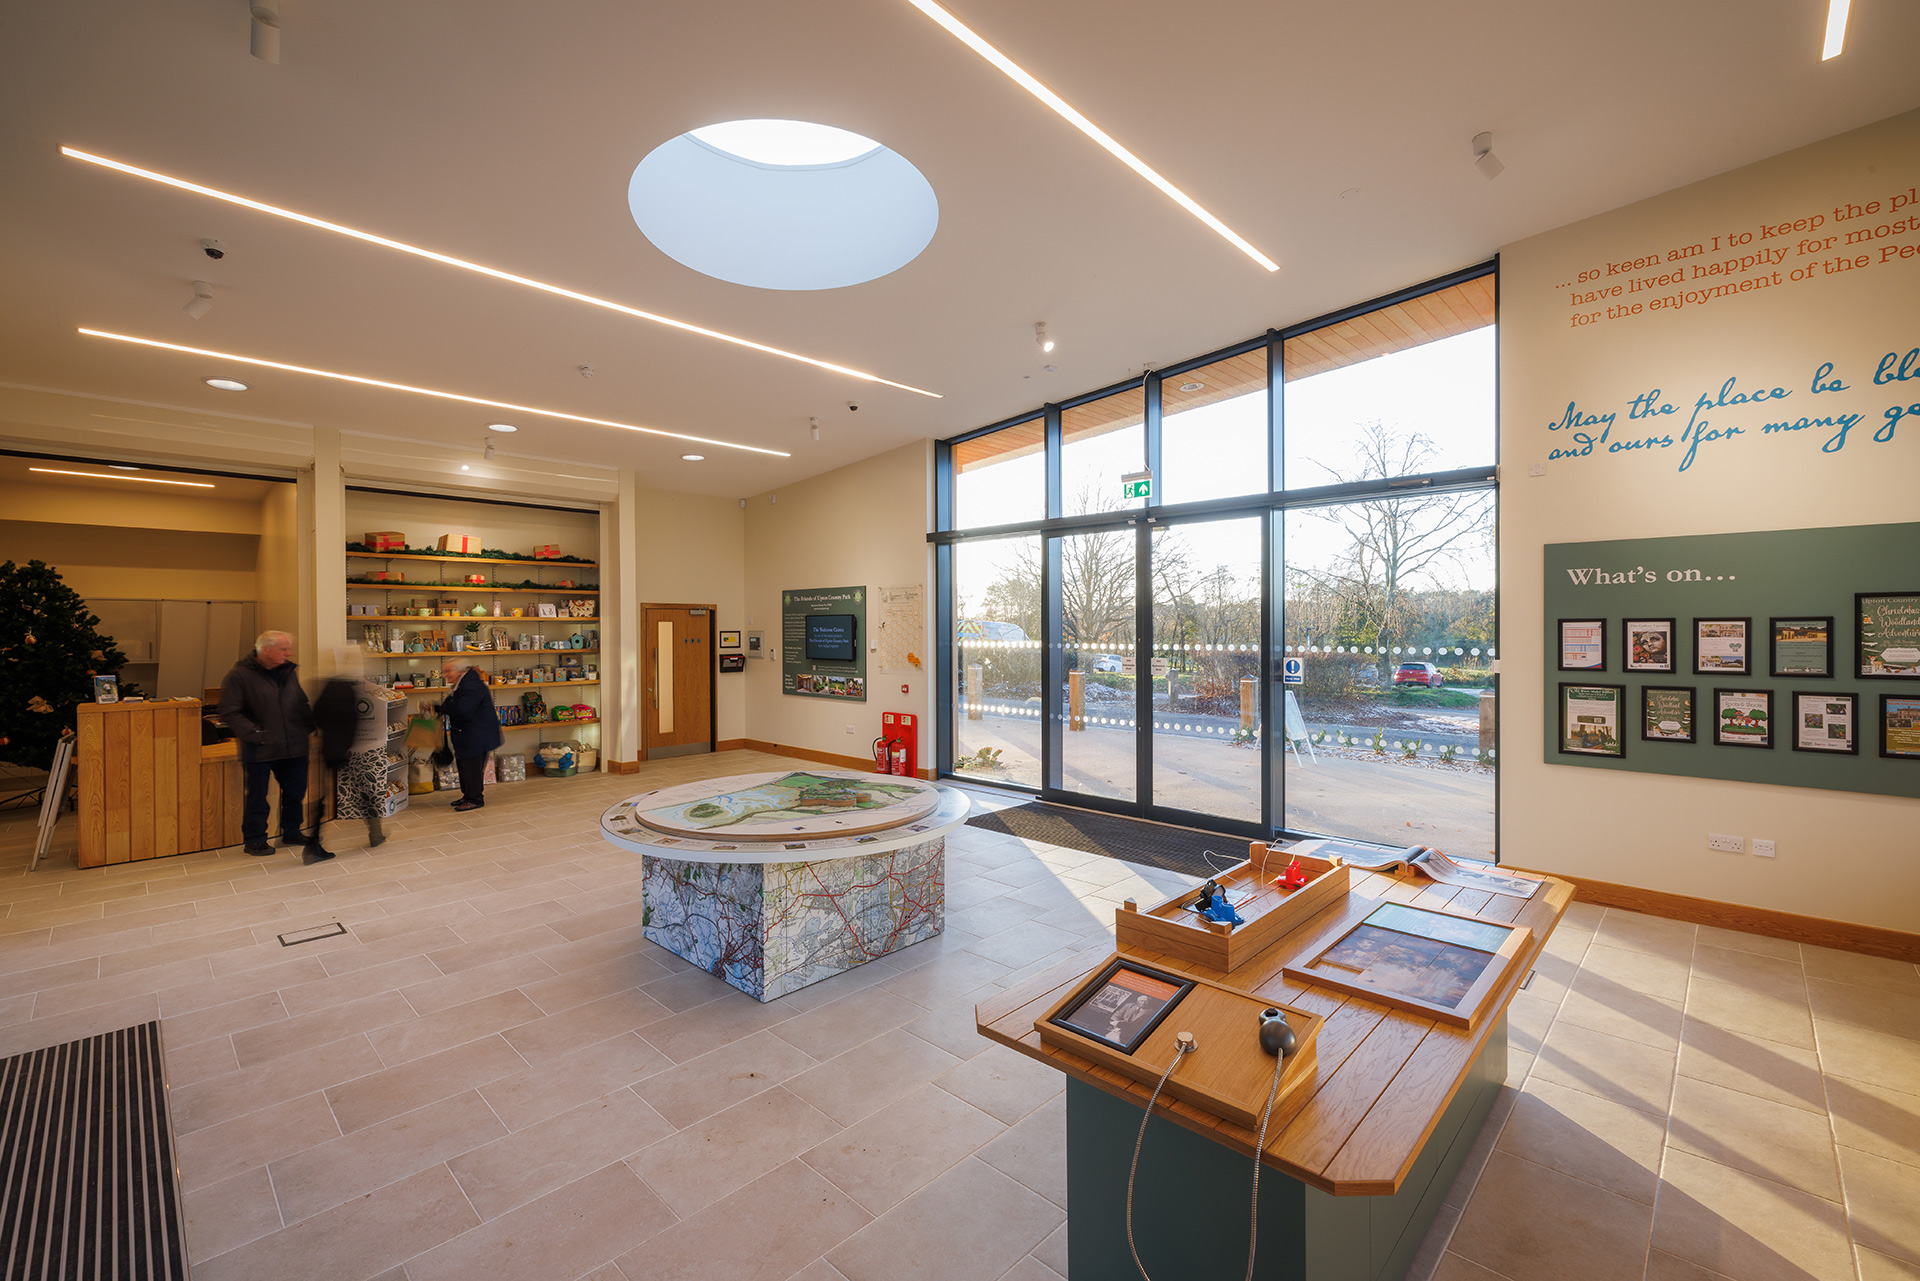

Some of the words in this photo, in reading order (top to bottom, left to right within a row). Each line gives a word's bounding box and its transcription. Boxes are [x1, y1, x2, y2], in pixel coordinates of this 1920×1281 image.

[1570, 286, 1623, 306] have
[1627, 269, 1685, 294] lived
[1691, 246, 1790, 280] happily
[1796, 236, 1838, 257] for
[1845, 215, 1920, 246] most
[1577, 268, 1601, 284] so
[1605, 253, 1661, 277] keen
[1667, 244, 1704, 262] am
[1711, 236, 1722, 252] I
[1727, 232, 1753, 248] to
[1759, 214, 1825, 241] keep
[1832, 200, 1881, 222] the
[1889, 188, 1920, 213] pl
[1570, 310, 1602, 328] for
[1606, 301, 1643, 320] the
[1649, 270, 1783, 310] enjoyment
[1789, 261, 1818, 281] of
[1822, 253, 1870, 275] the
[1877, 244, 1920, 264] Pe
[1548, 400, 1616, 443] May
[1627, 388, 1680, 420] the
[1680, 376, 1793, 442] place
[1810, 362, 1851, 394] be
[1548, 432, 1598, 461] and
[1608, 434, 1673, 454] ours
[1678, 419, 1745, 472] for
[1761, 413, 1866, 454] many
[1877, 605, 1920, 616] Christmas
